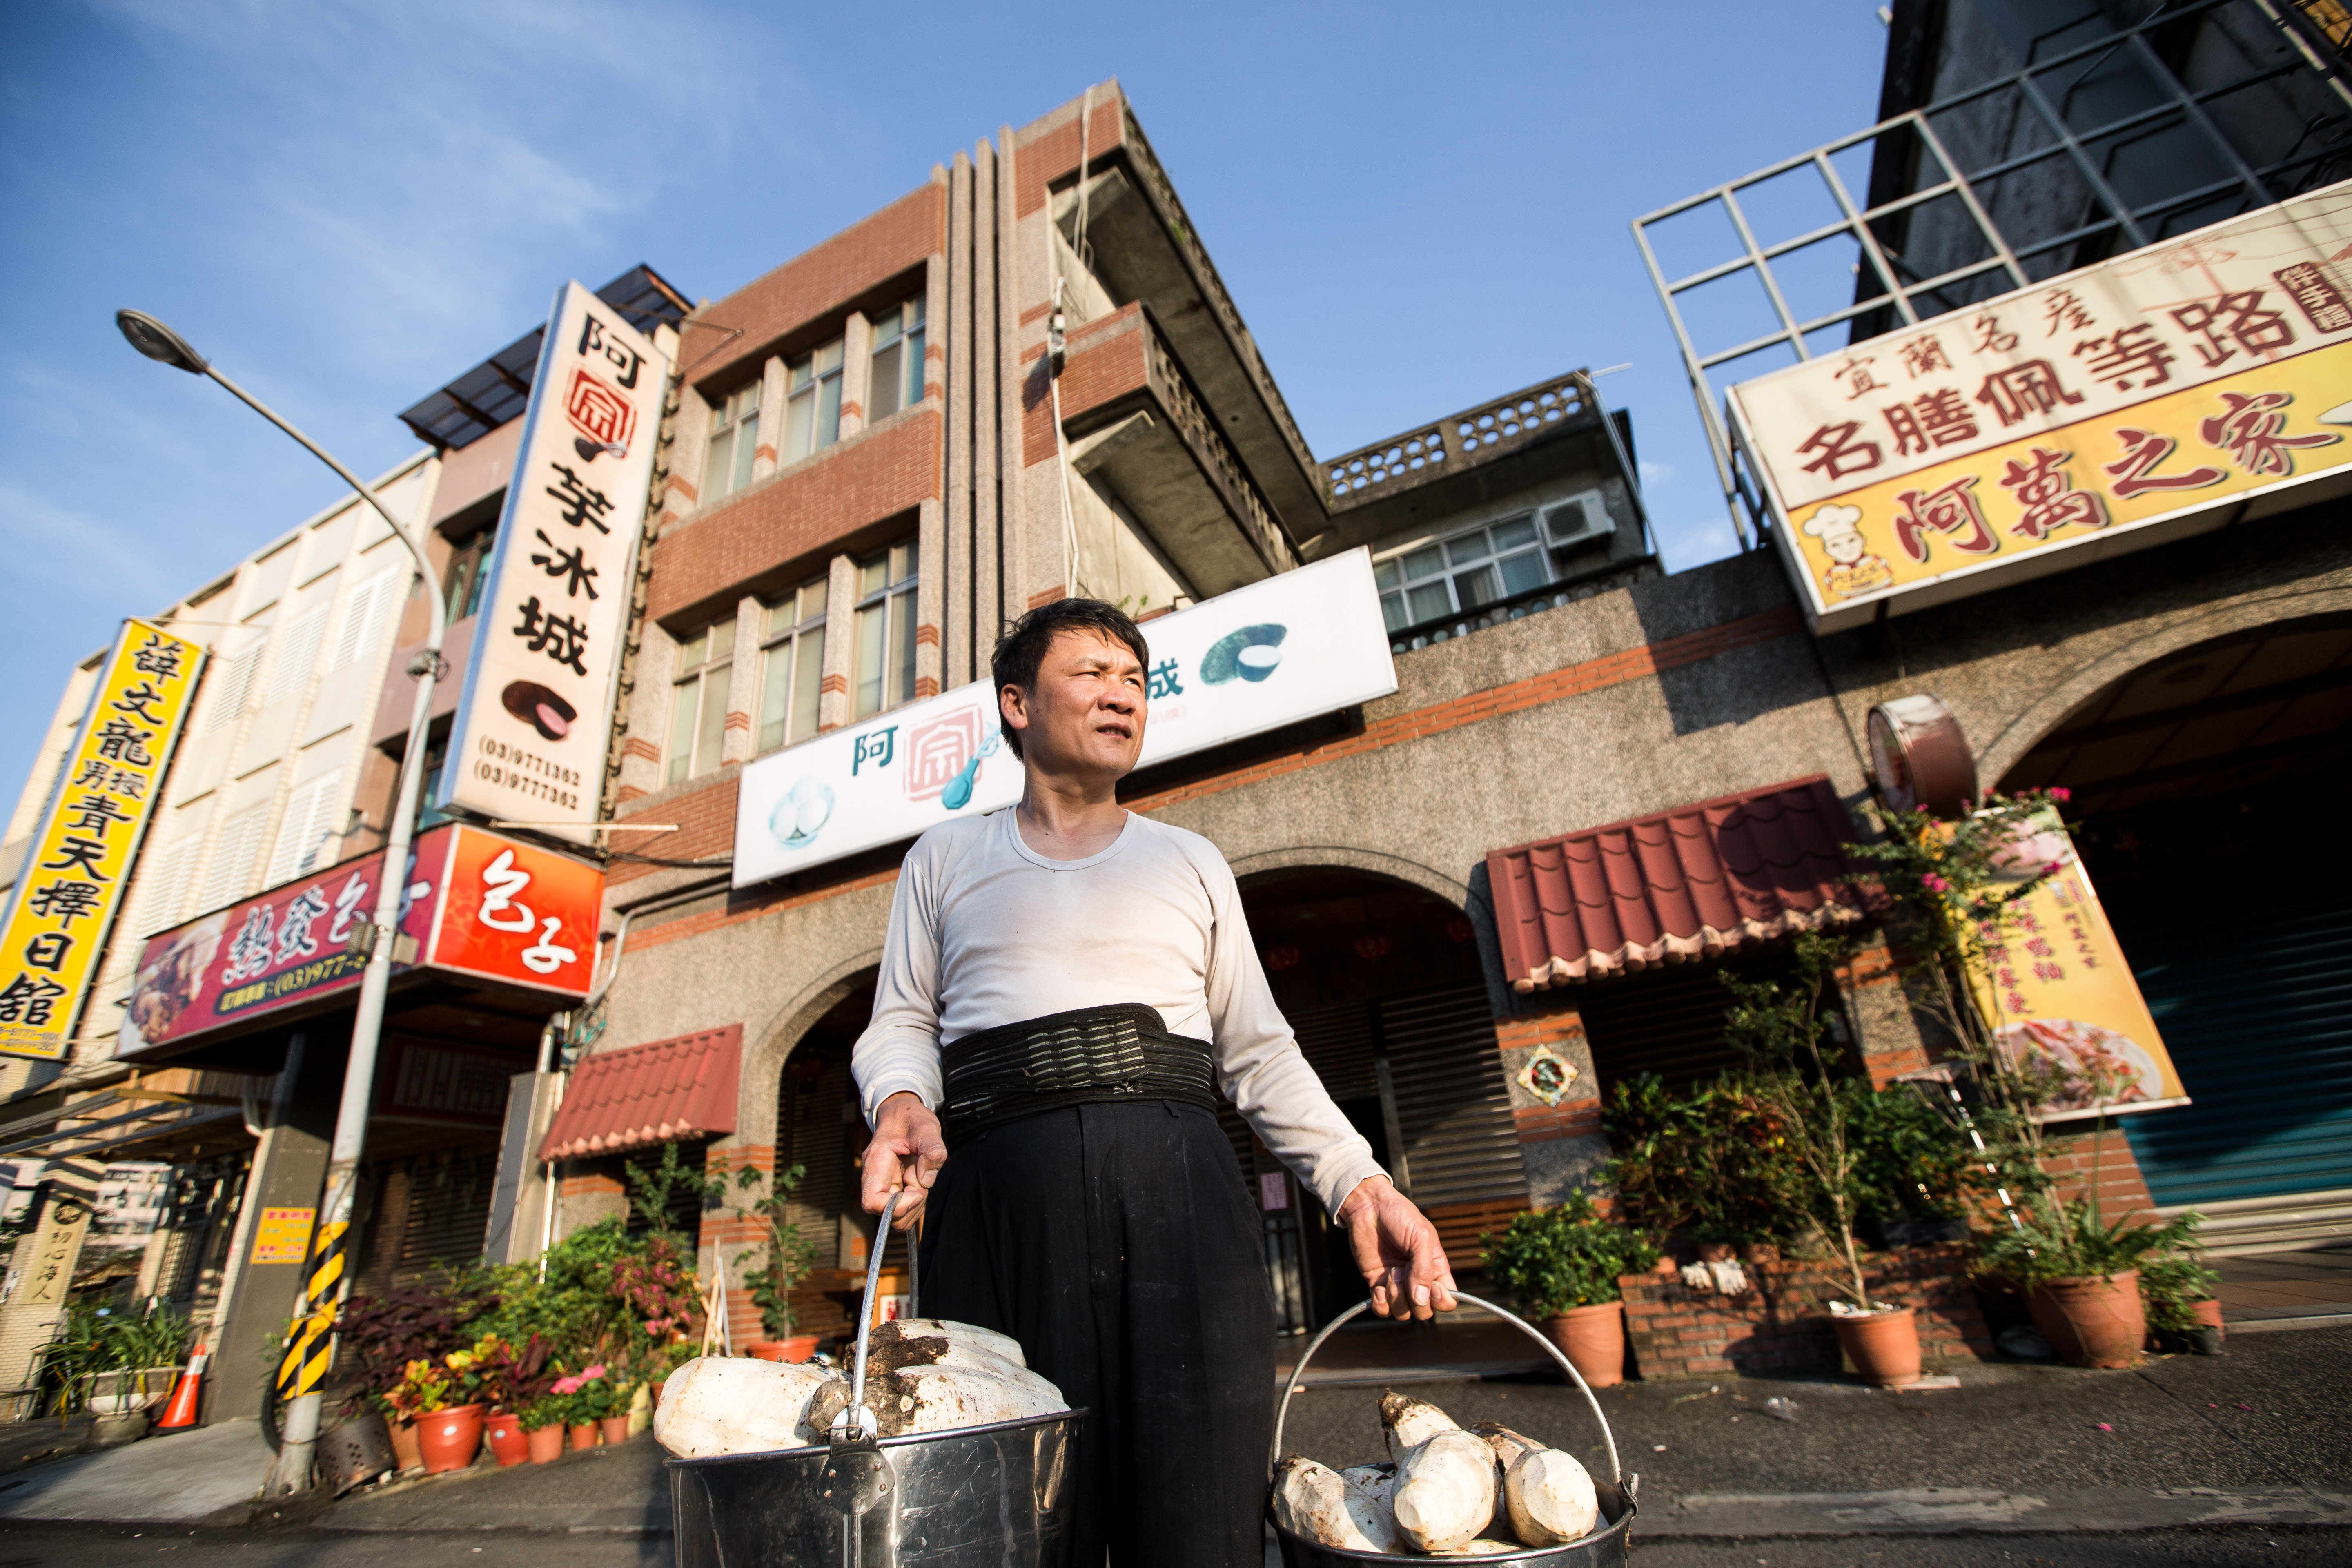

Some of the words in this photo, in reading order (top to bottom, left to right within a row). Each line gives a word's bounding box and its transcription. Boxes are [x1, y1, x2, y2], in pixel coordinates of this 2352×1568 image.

[1796, 289, 2298, 482] 名膳佩等路
[1833, 287, 2096, 401] 宜蘭名產
[1894, 391, 2342, 564] 阿萬之家
[478, 848, 577, 974] 包子
